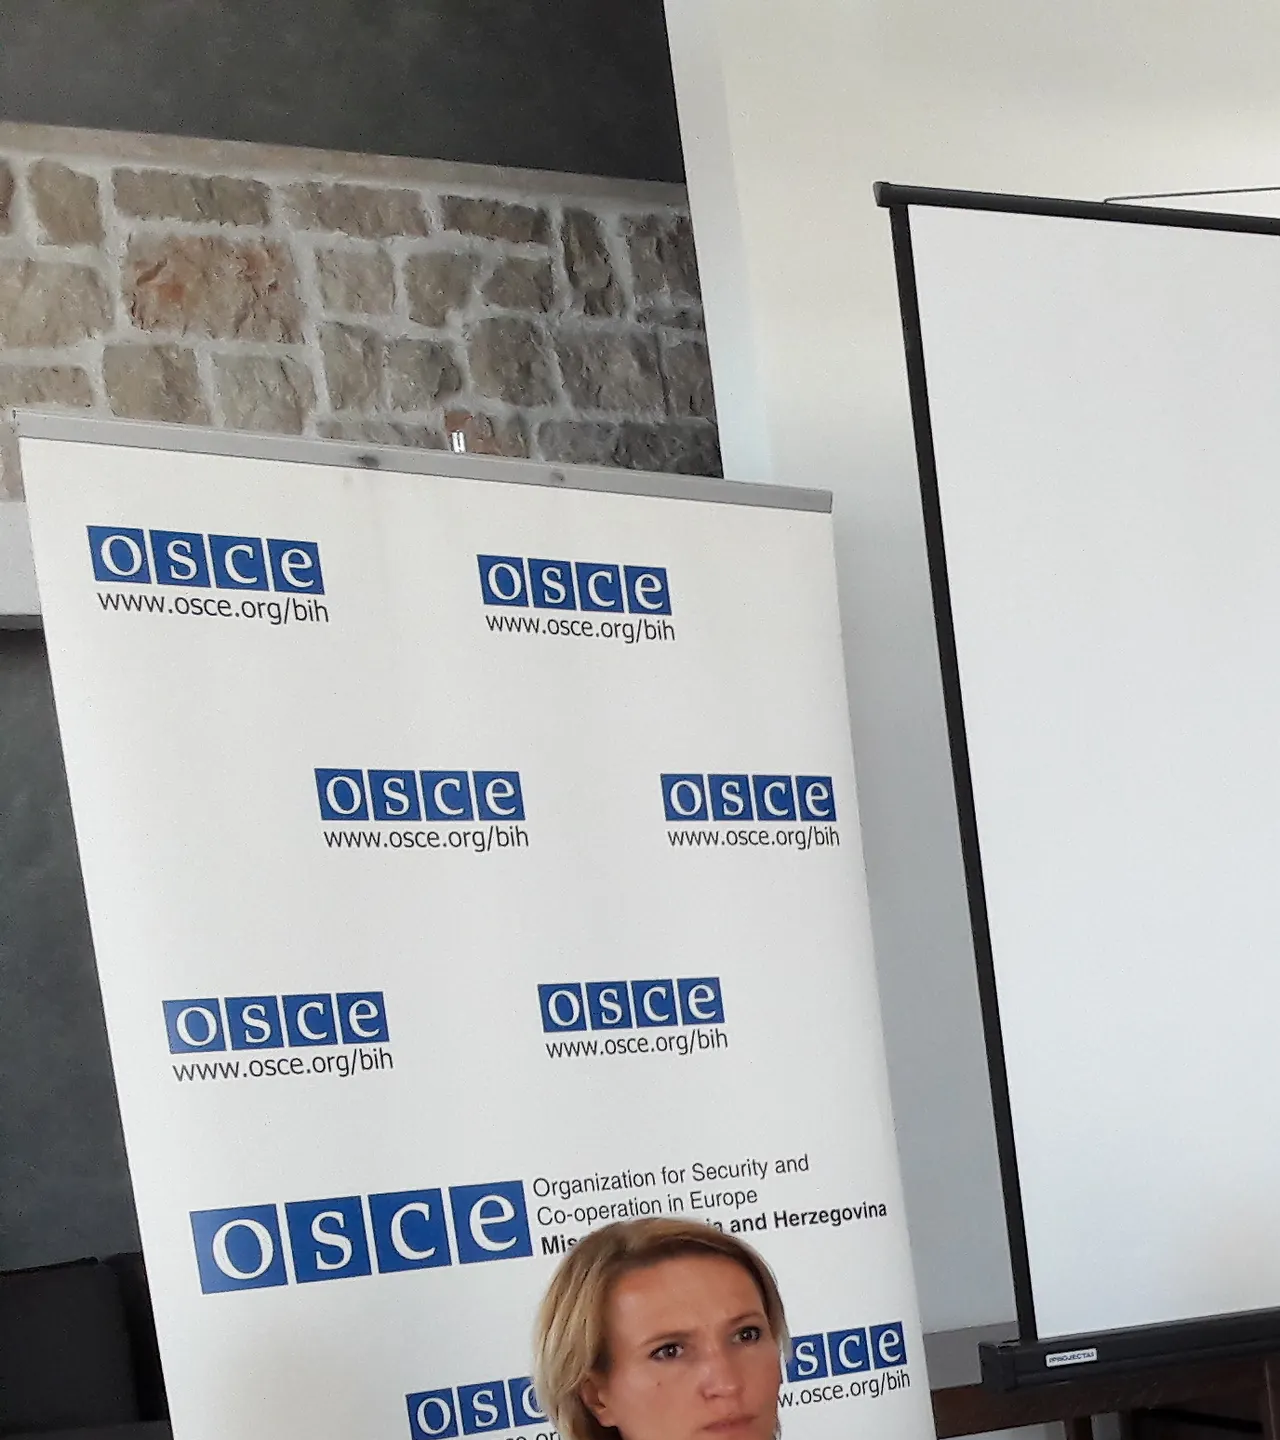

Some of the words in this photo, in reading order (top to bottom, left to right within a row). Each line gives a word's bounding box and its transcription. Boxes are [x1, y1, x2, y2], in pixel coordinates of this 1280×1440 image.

[97, 592, 329, 625] www.osce.org/bih
[485, 615, 676, 644] www.osce.org/bih
[323, 825, 529, 852] www.osce.org/bih
[667, 826, 840, 850] www.osce.org/bih
[545, 1028, 729, 1059] www.osce.org/bih
[172, 1048, 394, 1082] www.osce.org/bih
[533, 1169, 656, 1199] Organization
[661, 1166, 686, 1184] for
[692, 1159, 768, 1182] Security
[775, 1154, 809, 1173] and
[537, 1197, 662, 1226] Co-operation
[668, 1194, 684, 1212] in
[690, 1188, 758, 1210] Europe
[730, 1213, 768, 1233] and
[774, 1201, 888, 1230] Herzegovina
[793, 1326, 904, 1378] sce
[778, 1369, 911, 1408] w.osce.org/bih
[415, 1380, 549, 1437] osc
